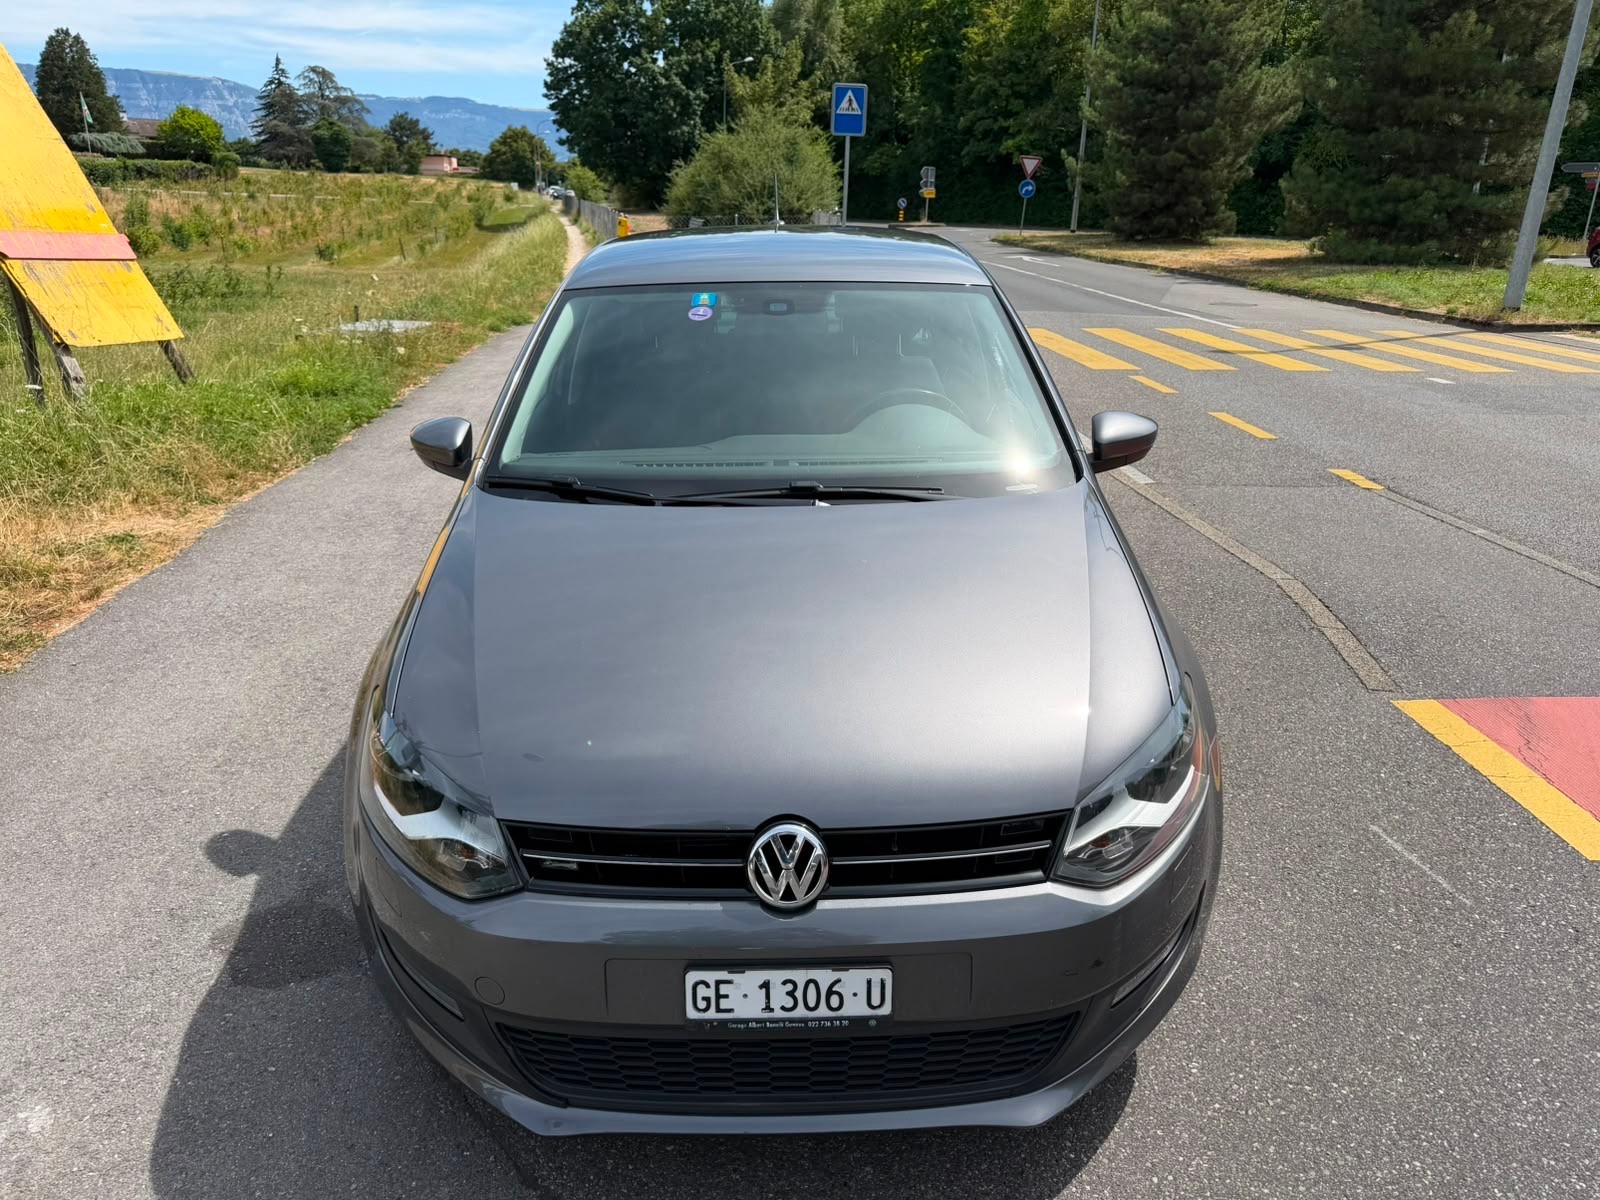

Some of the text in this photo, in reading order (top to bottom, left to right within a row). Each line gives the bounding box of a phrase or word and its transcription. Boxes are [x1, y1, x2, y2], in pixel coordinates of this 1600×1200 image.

[691, 977, 886, 1014] GE 1306 U
